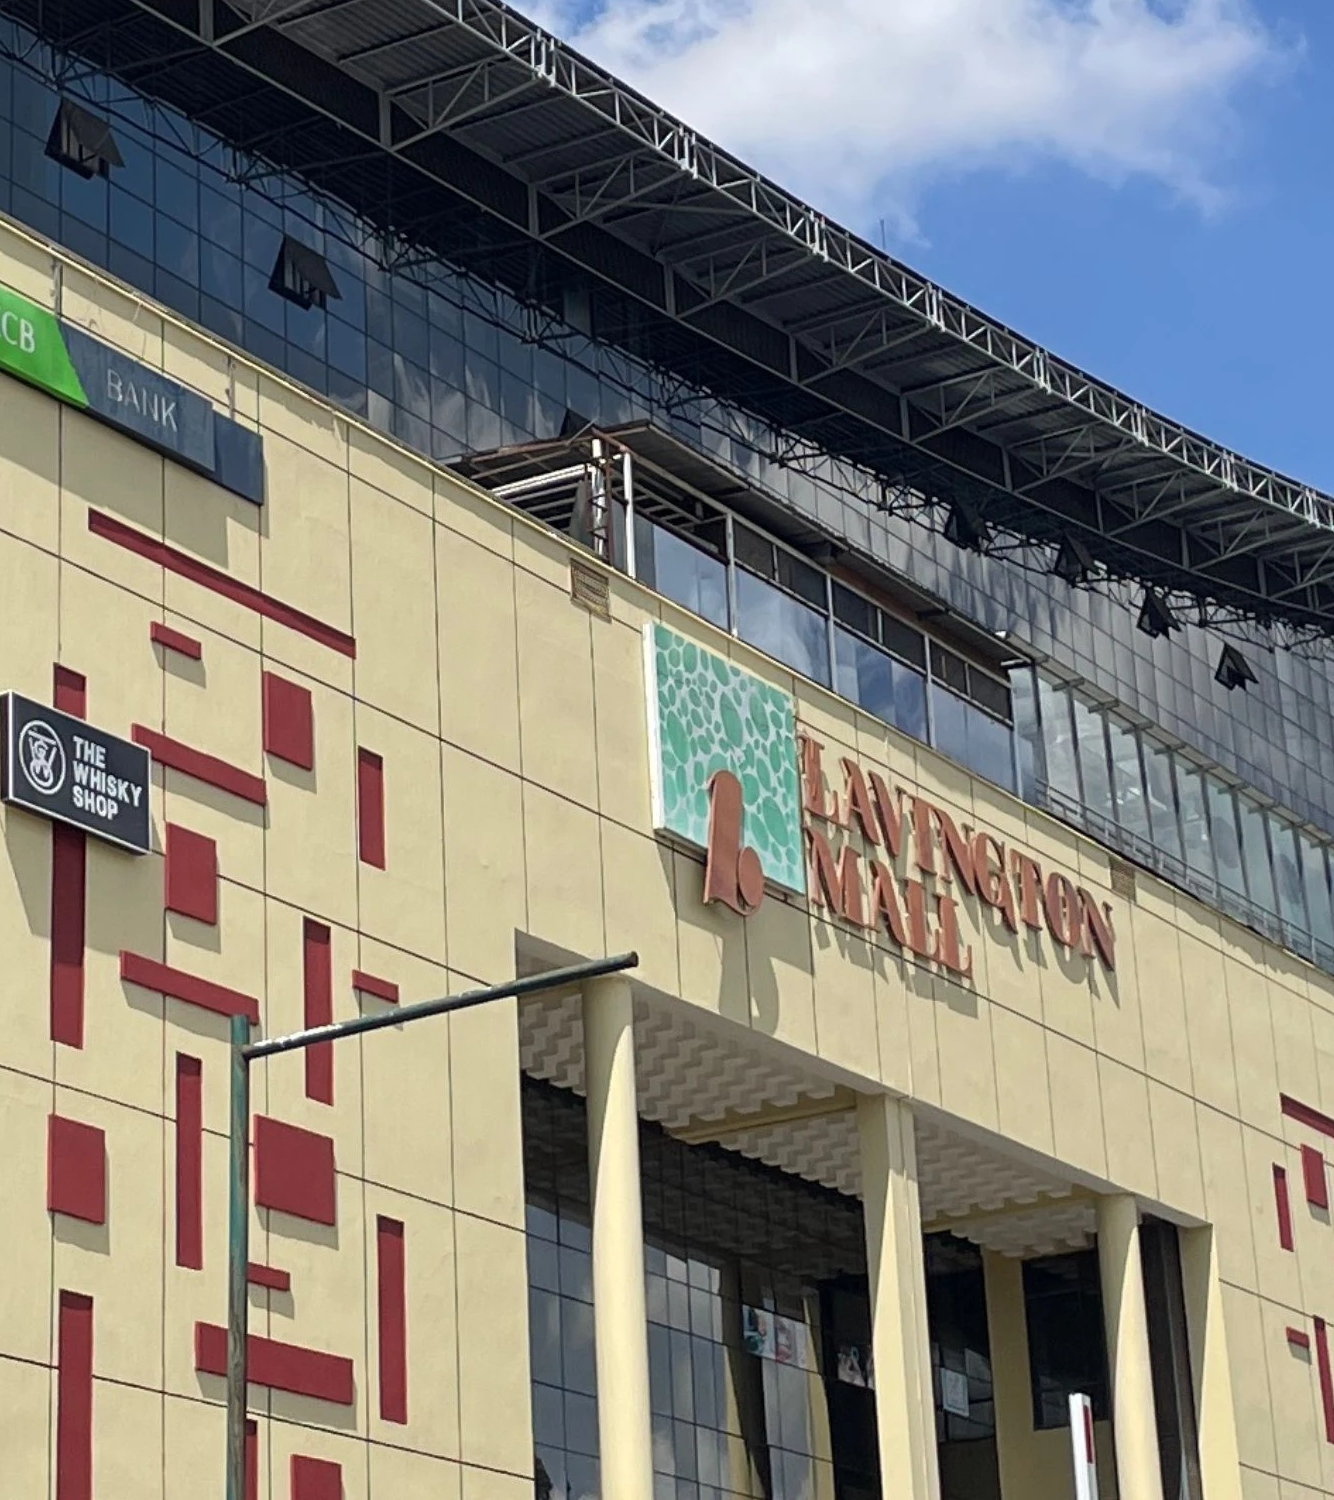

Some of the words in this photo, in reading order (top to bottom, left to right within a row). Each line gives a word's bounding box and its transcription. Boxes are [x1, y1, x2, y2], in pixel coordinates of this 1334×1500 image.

[107, 368, 178, 433] BANK
[72, 736, 107, 768] THE
[72, 760, 143, 808] WHISKY
[72, 785, 119, 821] SHOP
[796, 733, 1114, 972] LAVINGTON
[804, 825, 974, 980] MALL
